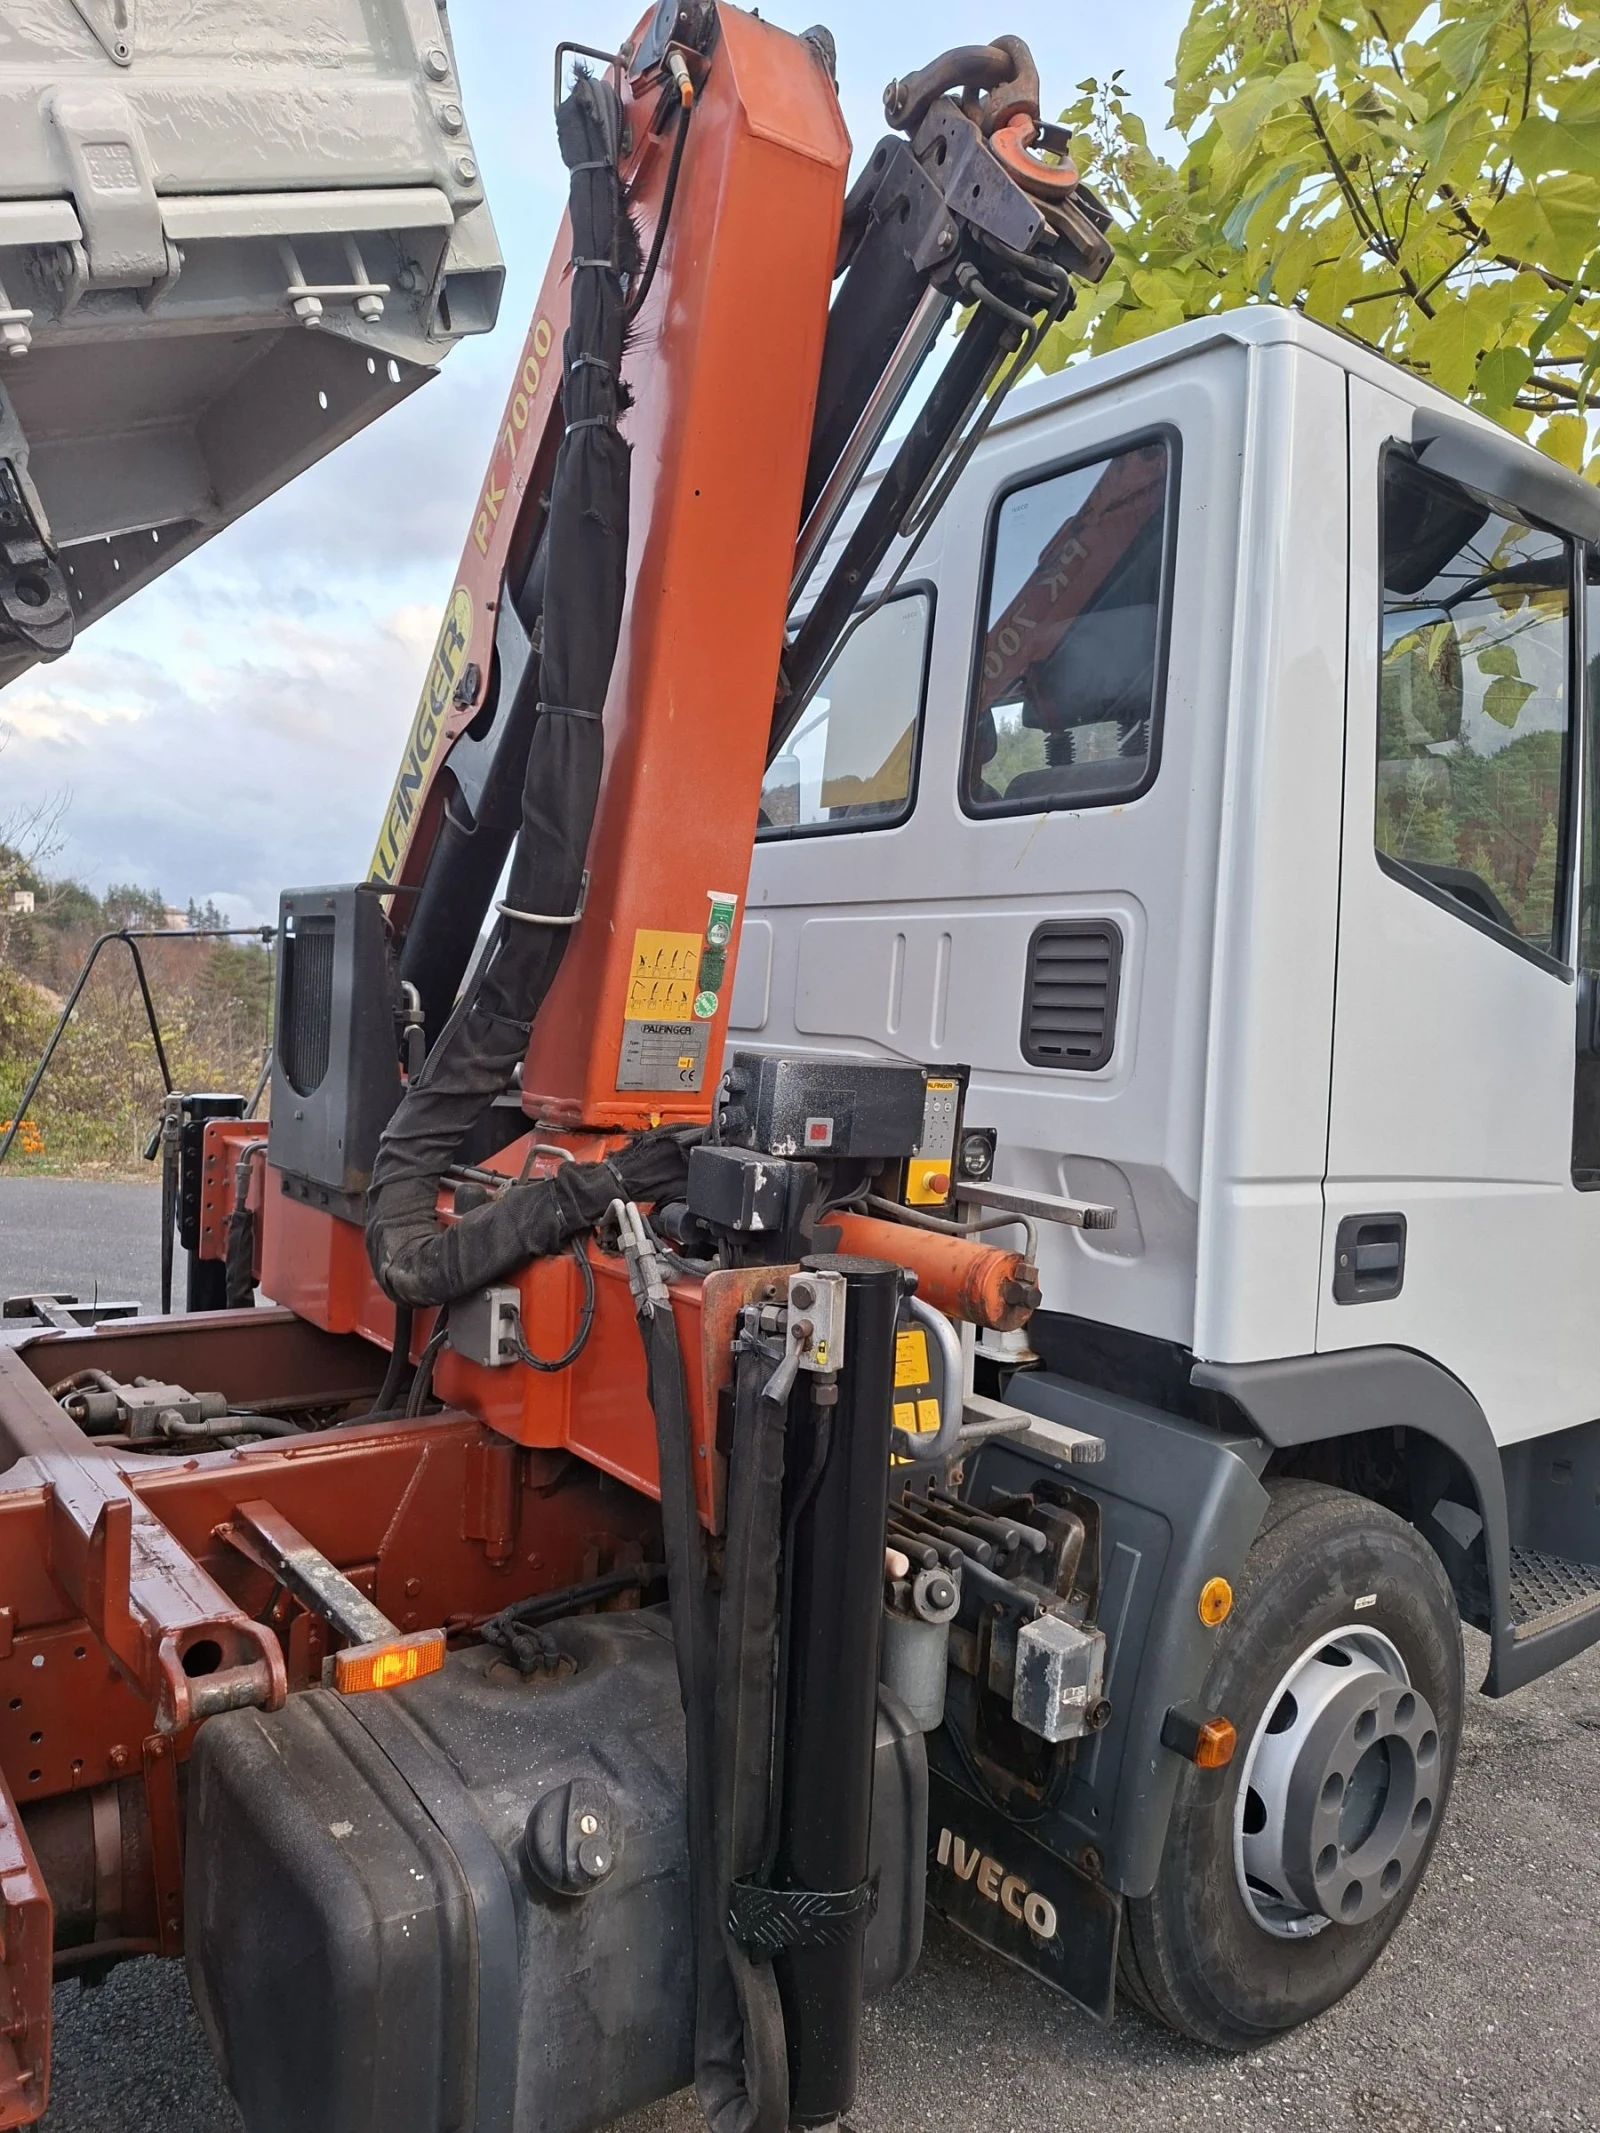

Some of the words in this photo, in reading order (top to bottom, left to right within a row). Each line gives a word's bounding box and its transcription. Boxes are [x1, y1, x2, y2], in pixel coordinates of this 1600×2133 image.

[473, 472, 506, 554] PK
[501, 318, 551, 457] 7000
[642, 1024, 692, 1035] PALFINGER
[679, 1069, 696, 1082] CE
[936, 1827, 1057, 1939] IVECO
